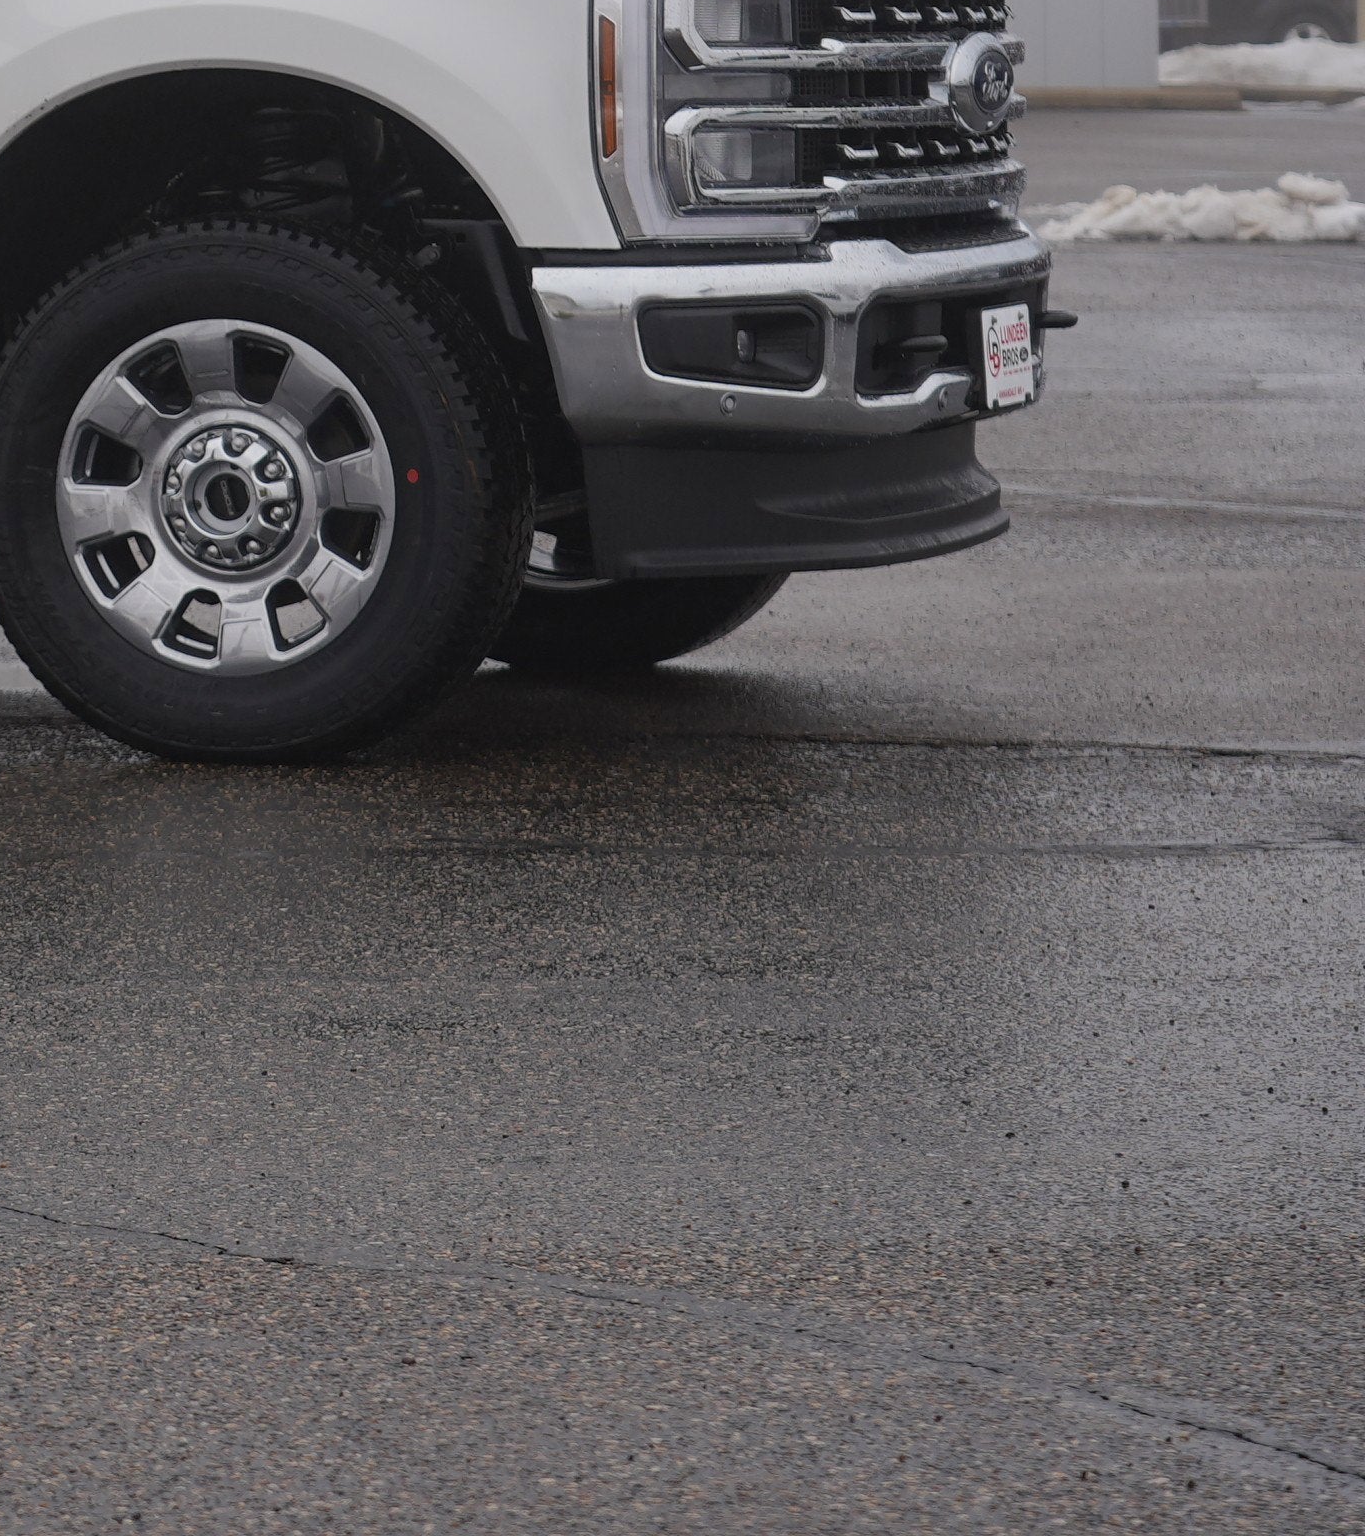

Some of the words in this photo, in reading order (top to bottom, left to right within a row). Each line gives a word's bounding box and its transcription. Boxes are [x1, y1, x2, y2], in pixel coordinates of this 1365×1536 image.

[982, 60, 1009, 104] Ford
[999, 322, 1029, 345] LUNDEEN
[1002, 346, 1020, 368] BROS
